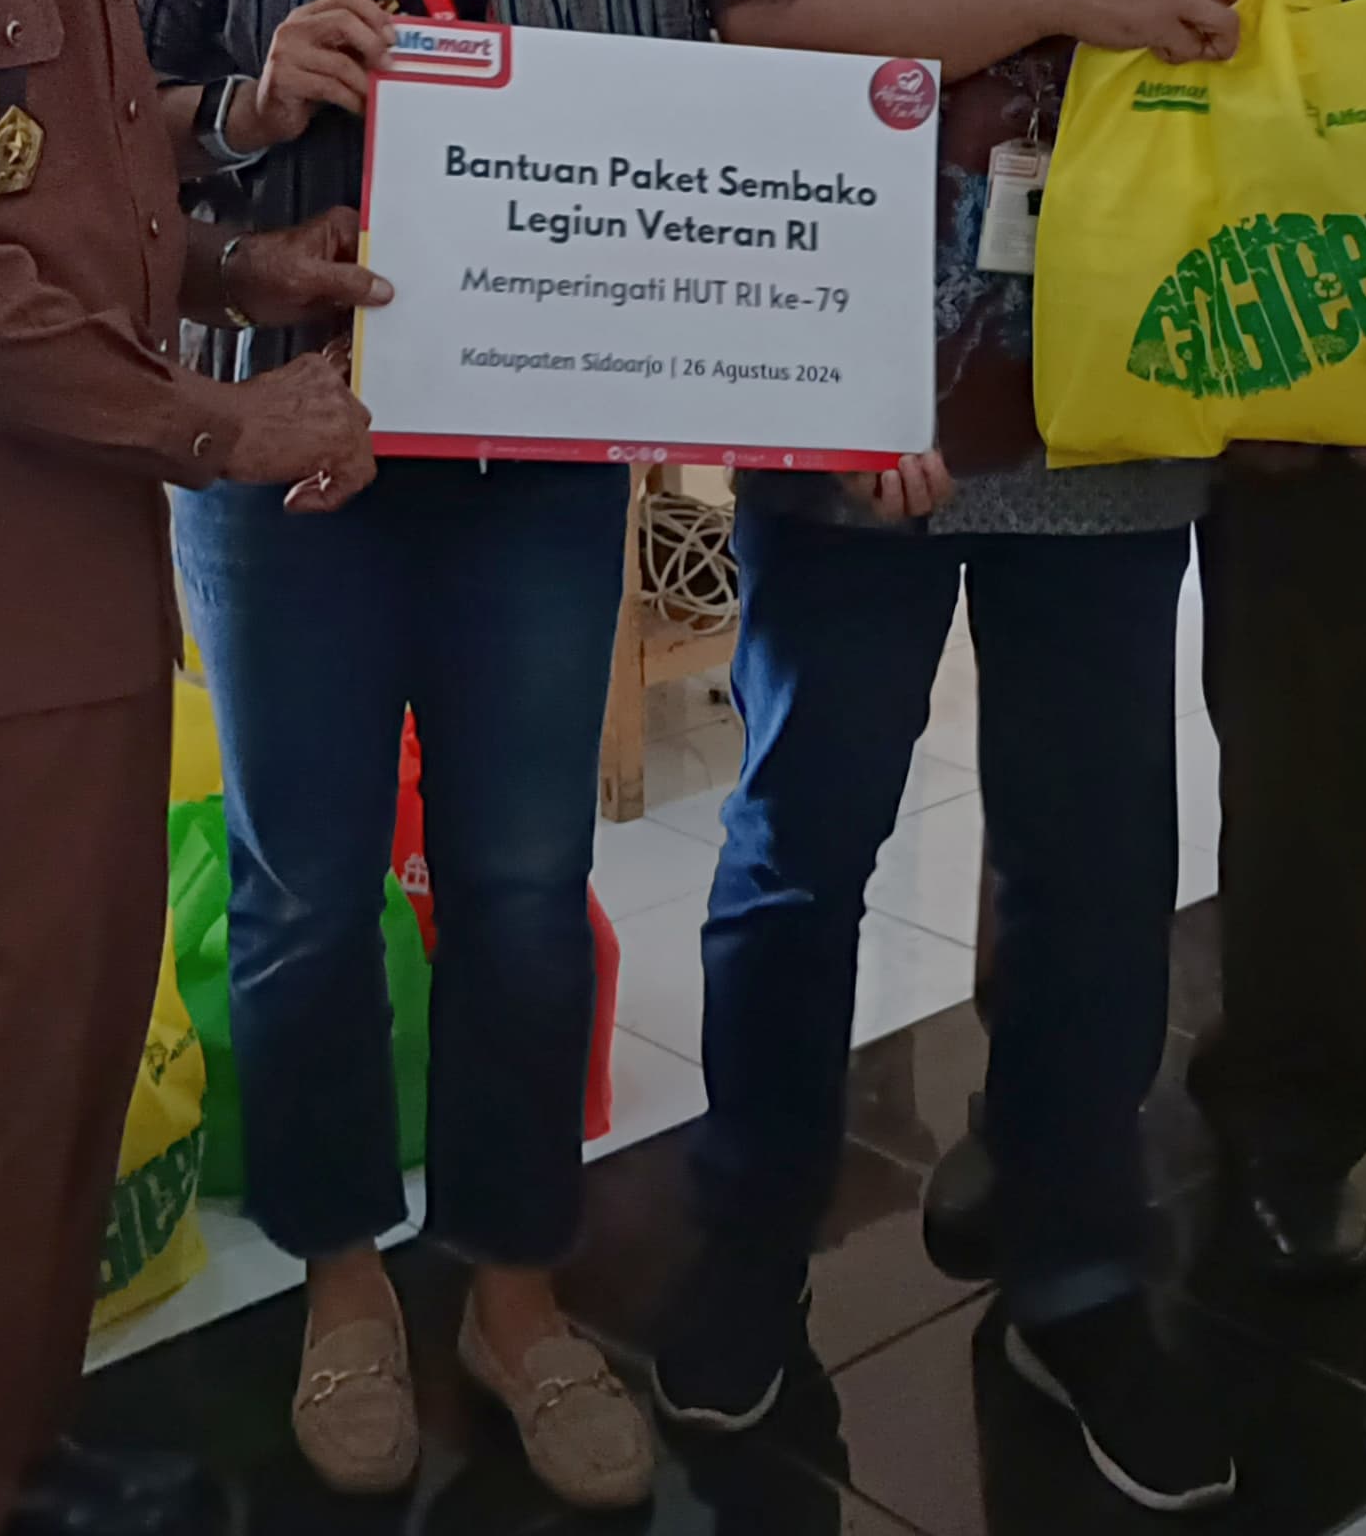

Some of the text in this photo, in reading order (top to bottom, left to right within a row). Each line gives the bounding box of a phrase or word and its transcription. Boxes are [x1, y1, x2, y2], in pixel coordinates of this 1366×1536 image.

[445, 144, 878, 207] Bantuan Paket Sembako
[507, 199, 818, 252] Legiun Veteran RI
[460, 267, 850, 313] Memperingati HUT RI ke-79
[460, 347, 576, 373] Kabupaten
[581, 352, 663, 379] Sidoarjo
[682, 358, 706, 377] 26
[711, 360, 790, 384] Agustus
[795, 364, 842, 384] 2024
